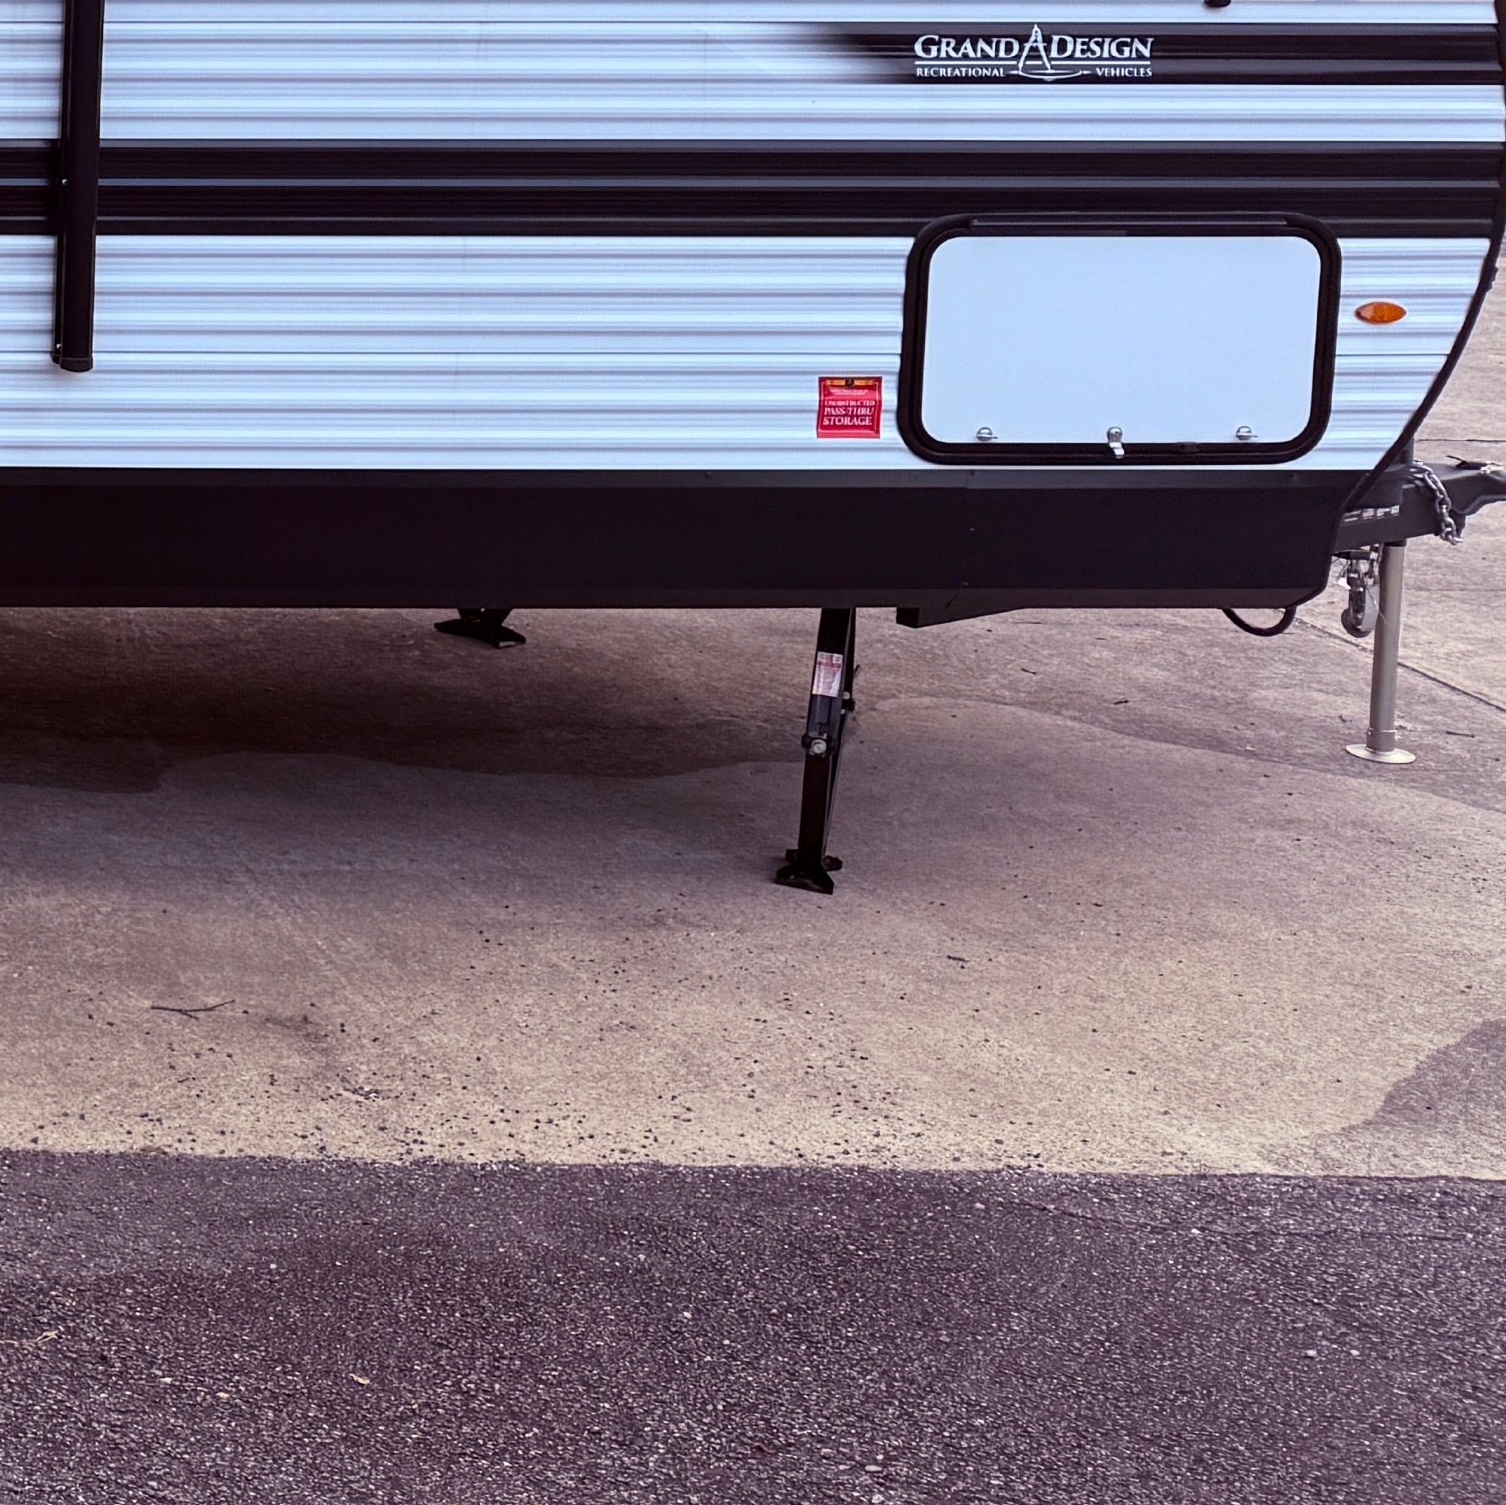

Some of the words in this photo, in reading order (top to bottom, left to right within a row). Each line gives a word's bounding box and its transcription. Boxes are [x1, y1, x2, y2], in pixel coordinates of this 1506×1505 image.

[914, 34, 1020, 58] GRAND
[1050, 34, 1154, 58] DESIGN
[916, 67, 1006, 78] RECREATIONAL
[1095, 67, 1153, 78] VEHICLES
[823, 416, 872, 425] STORAGE
